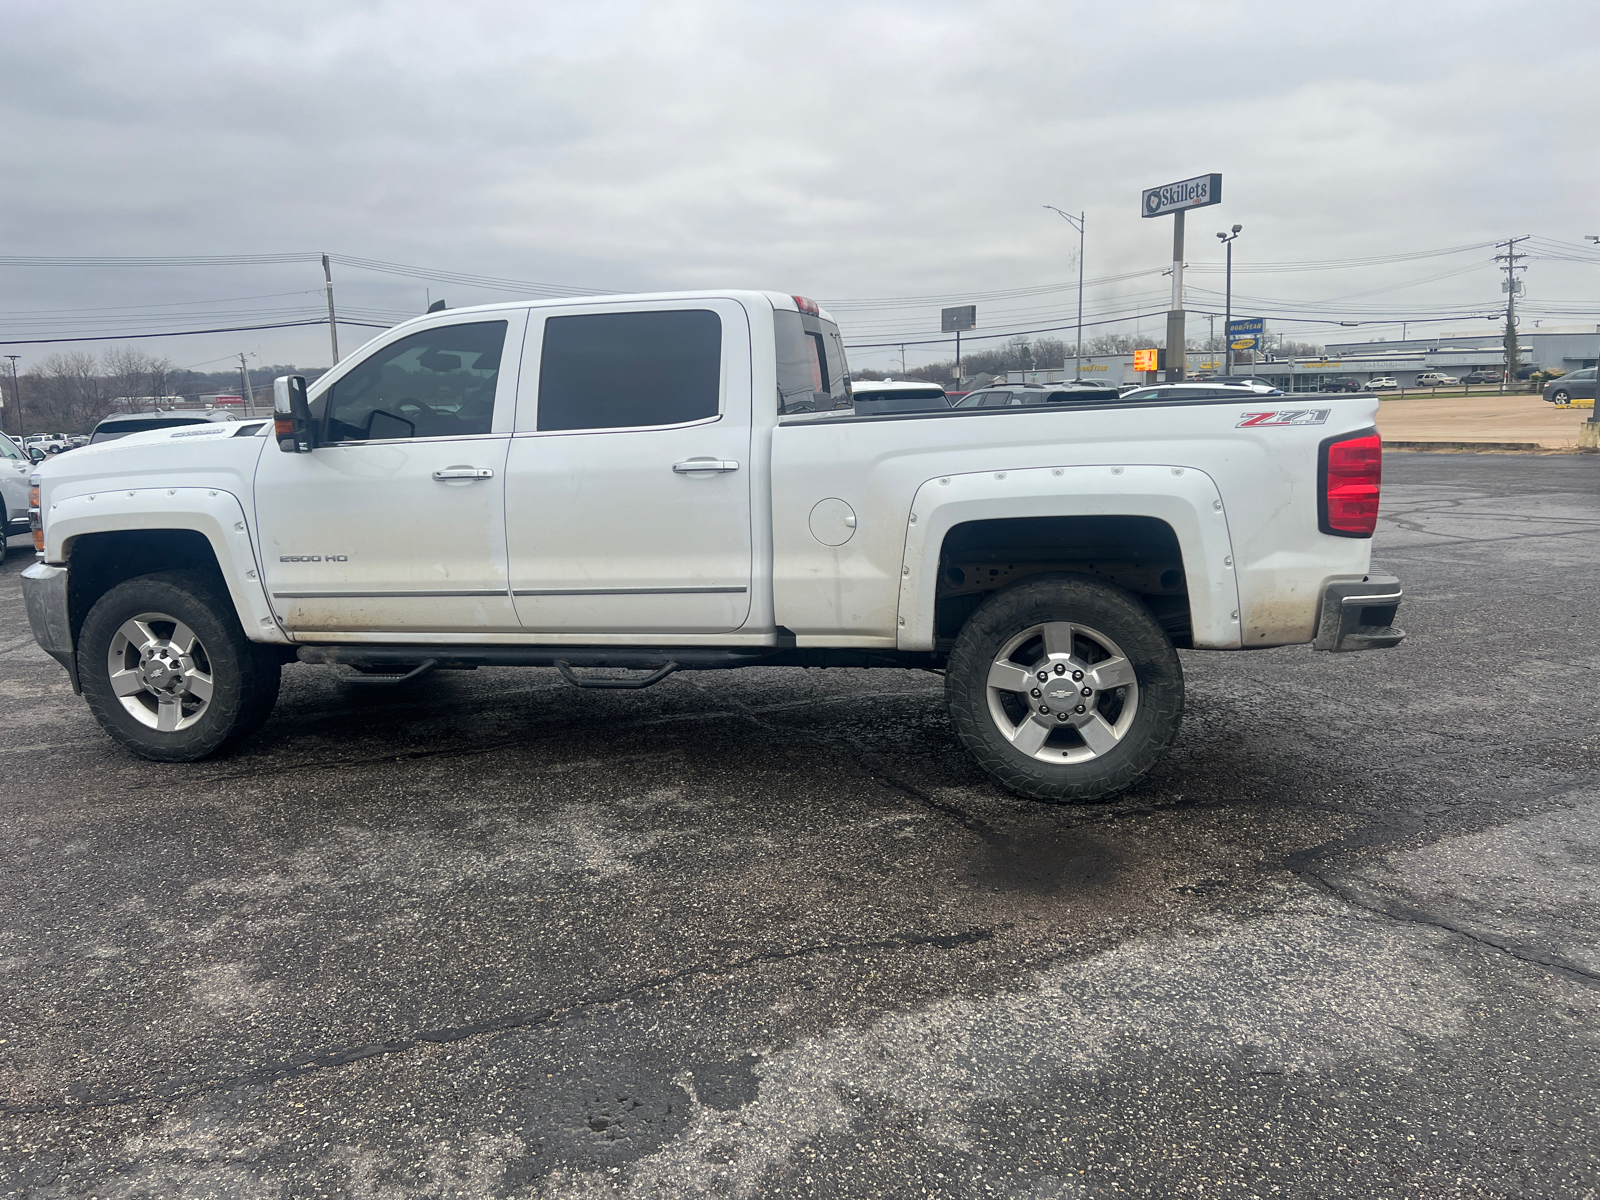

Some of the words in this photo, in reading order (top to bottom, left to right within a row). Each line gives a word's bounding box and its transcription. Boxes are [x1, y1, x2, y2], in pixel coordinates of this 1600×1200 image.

[1162, 183, 1207, 206] Skillets
[1230, 322, 1262, 332] OODYEAR
[1235, 409, 1332, 429] Z71
[279, 555, 322, 563] 2500
[325, 555, 348, 563] HD
[1108, 621, 1147, 662] TOYO
